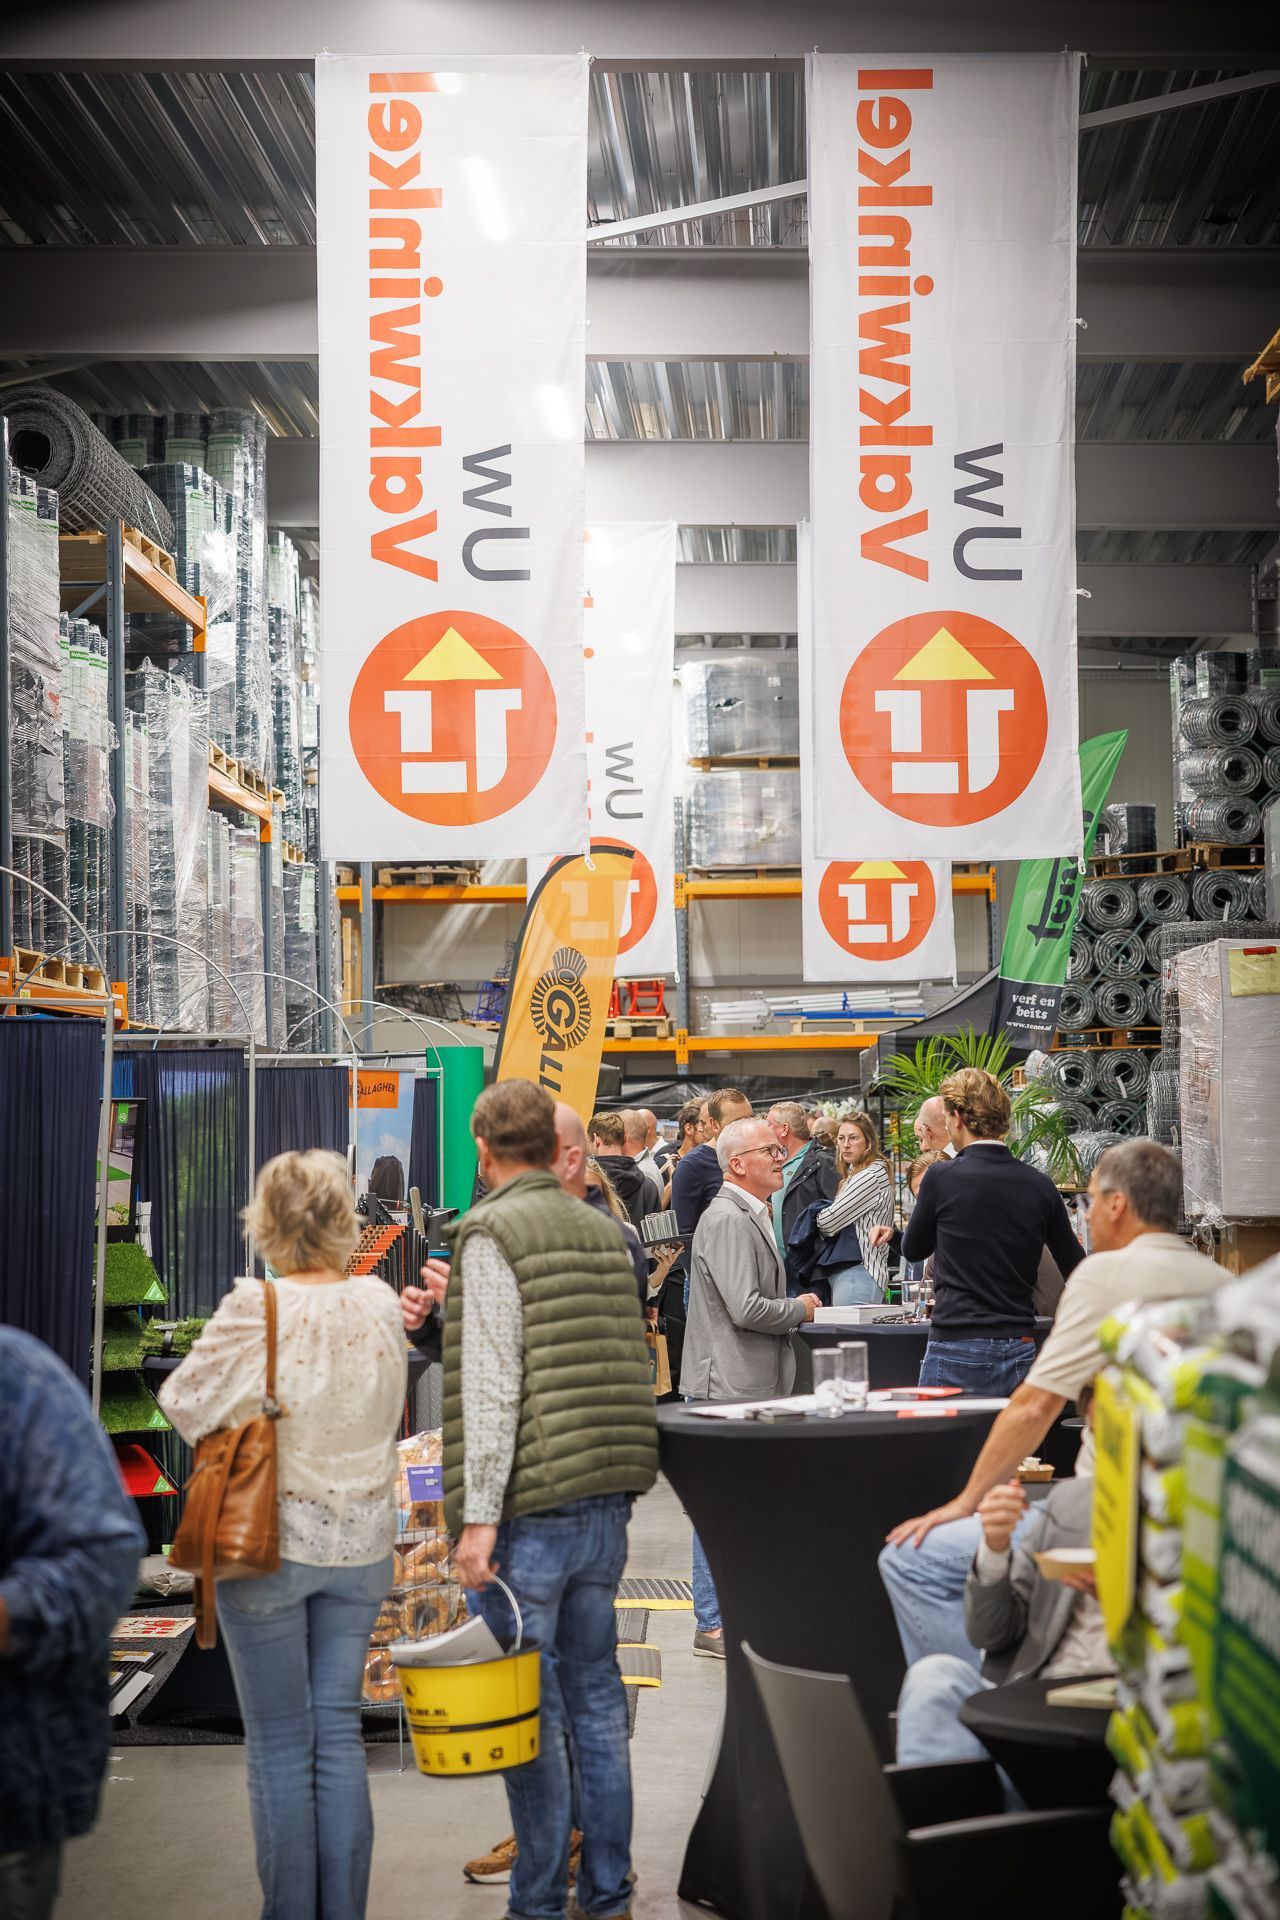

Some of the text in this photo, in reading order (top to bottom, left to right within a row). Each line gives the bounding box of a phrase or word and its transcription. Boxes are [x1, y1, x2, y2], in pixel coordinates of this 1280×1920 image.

[1012, 994, 1055, 1007] verf en
[1016, 1006, 1048, 1020] beits
[1006, 1021, 1052, 1031] www.tenco.nl
